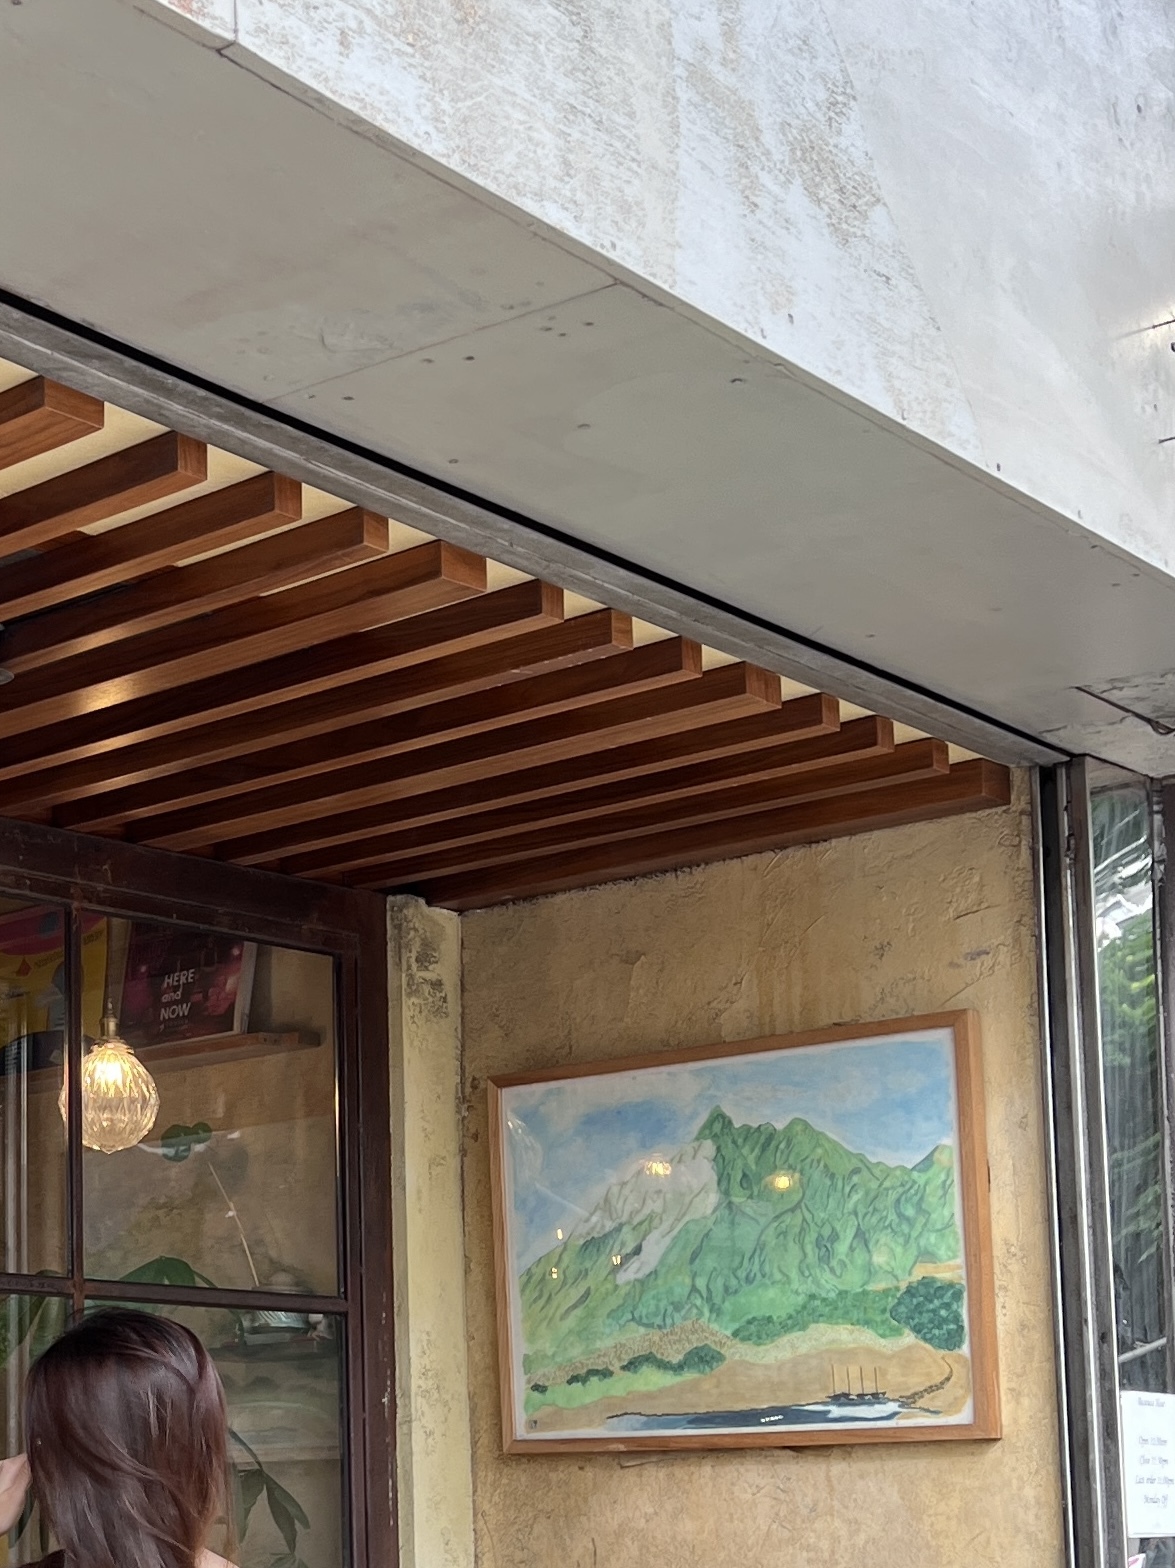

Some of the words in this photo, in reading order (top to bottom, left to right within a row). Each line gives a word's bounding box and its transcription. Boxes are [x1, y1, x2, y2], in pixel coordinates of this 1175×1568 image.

[164, 969, 195, 987] HERE
[162, 983, 182, 1002] and
[160, 1002, 191, 1021] NOW
